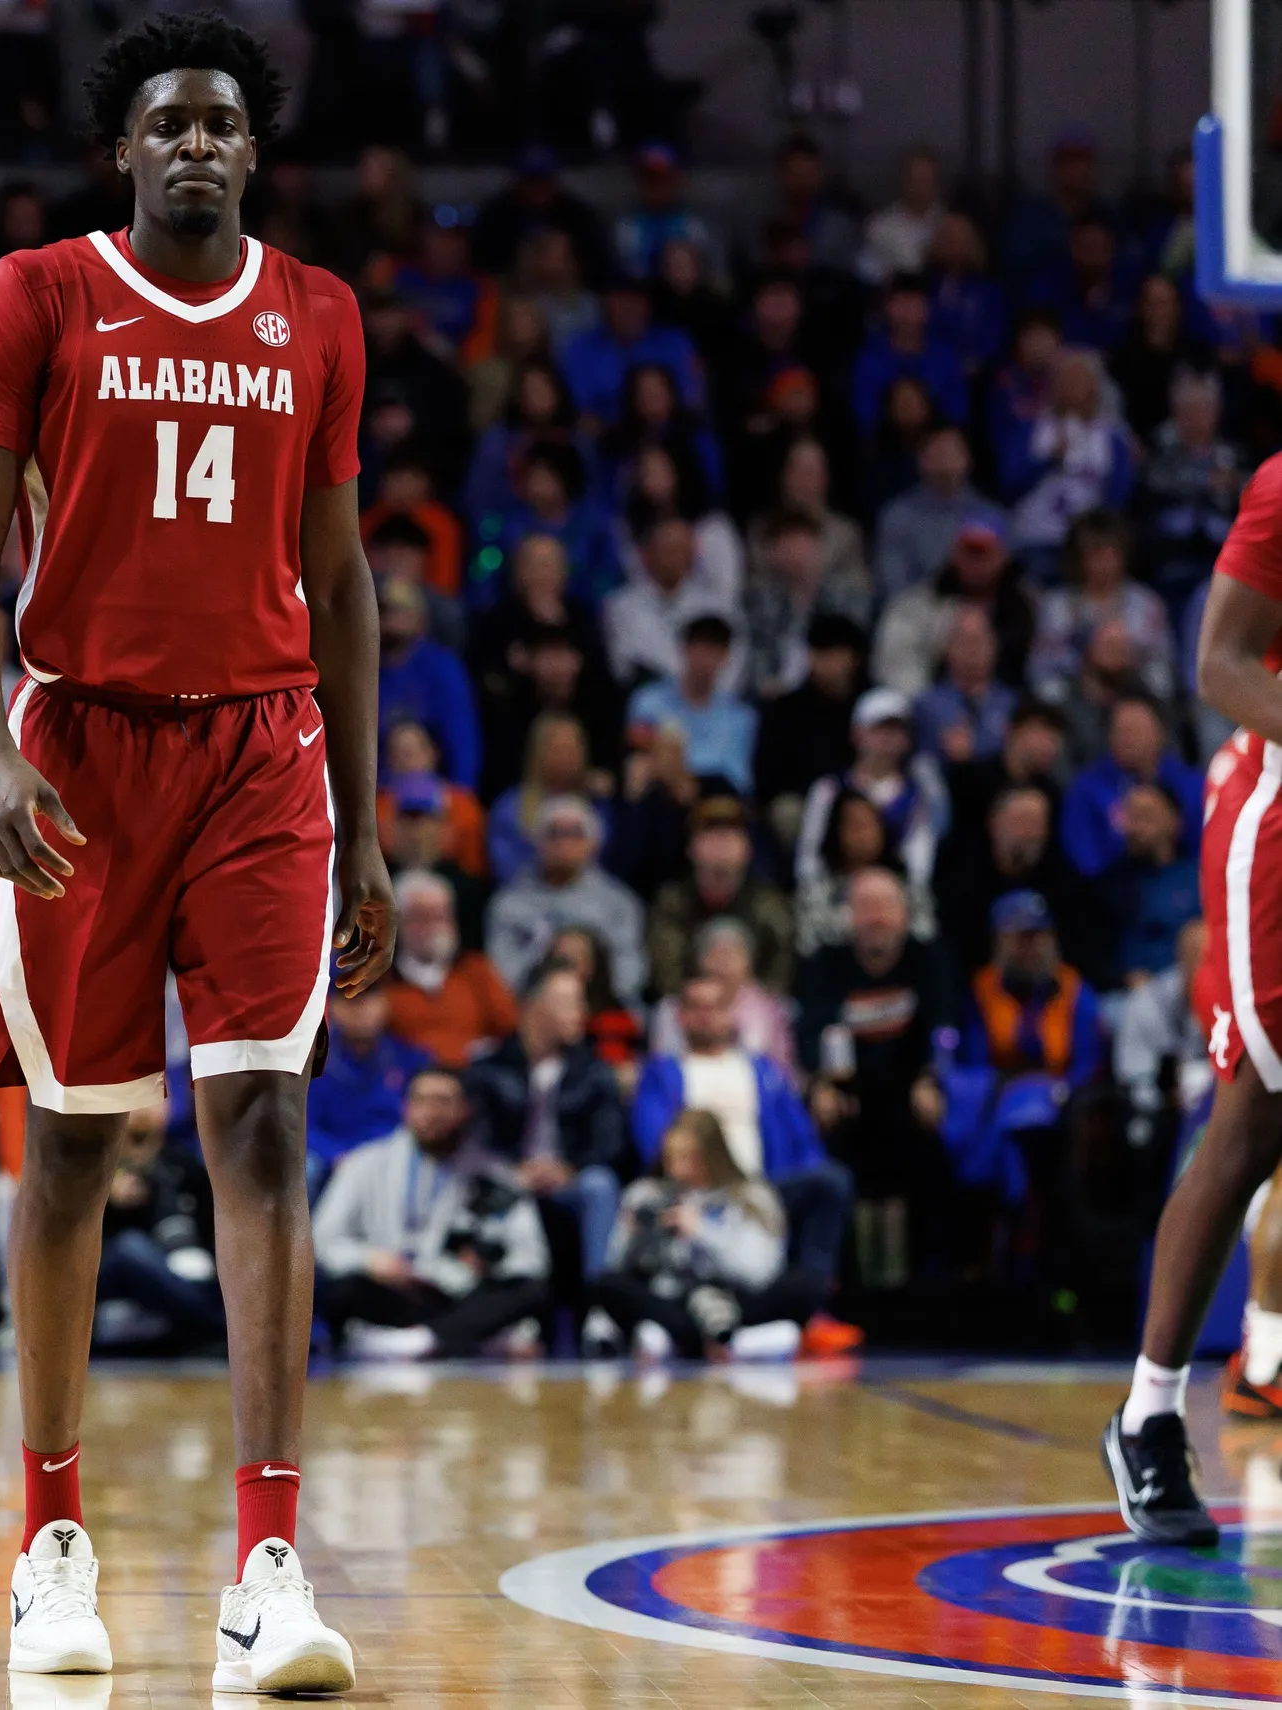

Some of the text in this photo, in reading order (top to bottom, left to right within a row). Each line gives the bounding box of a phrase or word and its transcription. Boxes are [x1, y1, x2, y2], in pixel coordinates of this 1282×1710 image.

[256, 313, 288, 344] SEC
[97, 355, 294, 416] ALABAMA
[153, 420, 235, 523] 14
